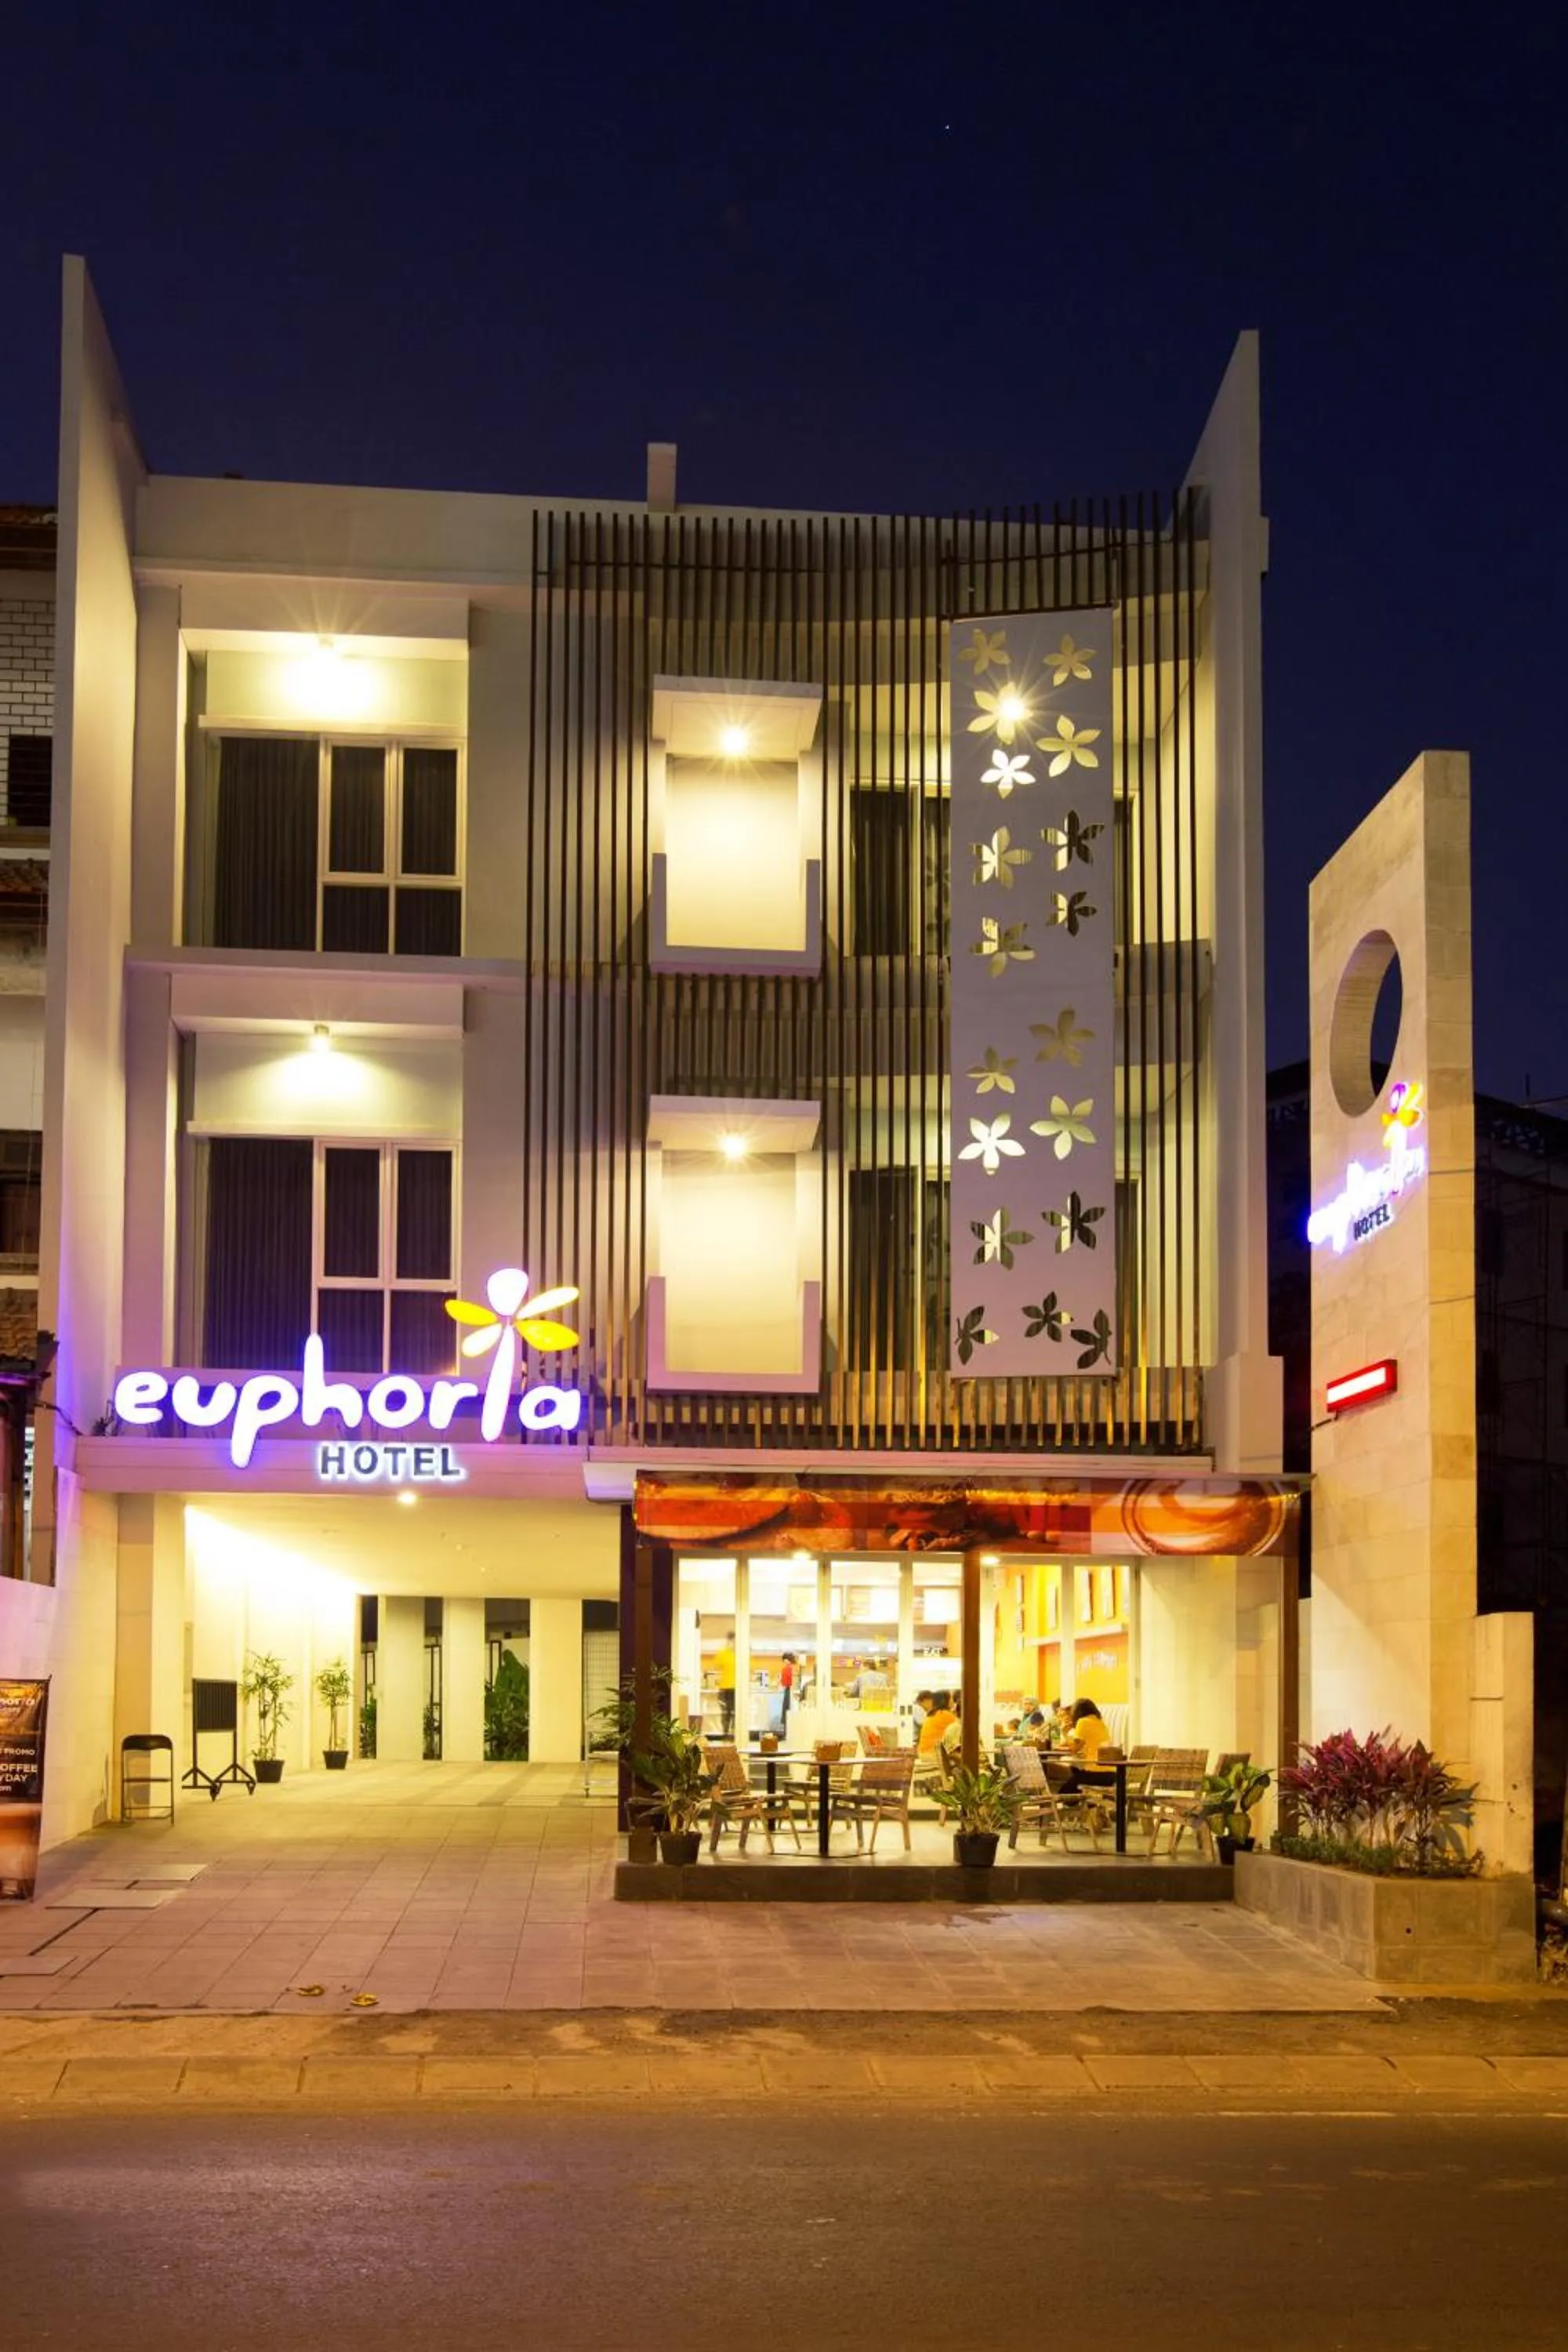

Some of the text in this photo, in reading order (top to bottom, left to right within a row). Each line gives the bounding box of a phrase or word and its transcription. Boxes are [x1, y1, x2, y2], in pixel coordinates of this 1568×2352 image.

[1353, 1203, 1392, 1241] HOTEL
[114, 1268, 581, 1468] euphoria
[320, 1445, 461, 1477] HOTEL
